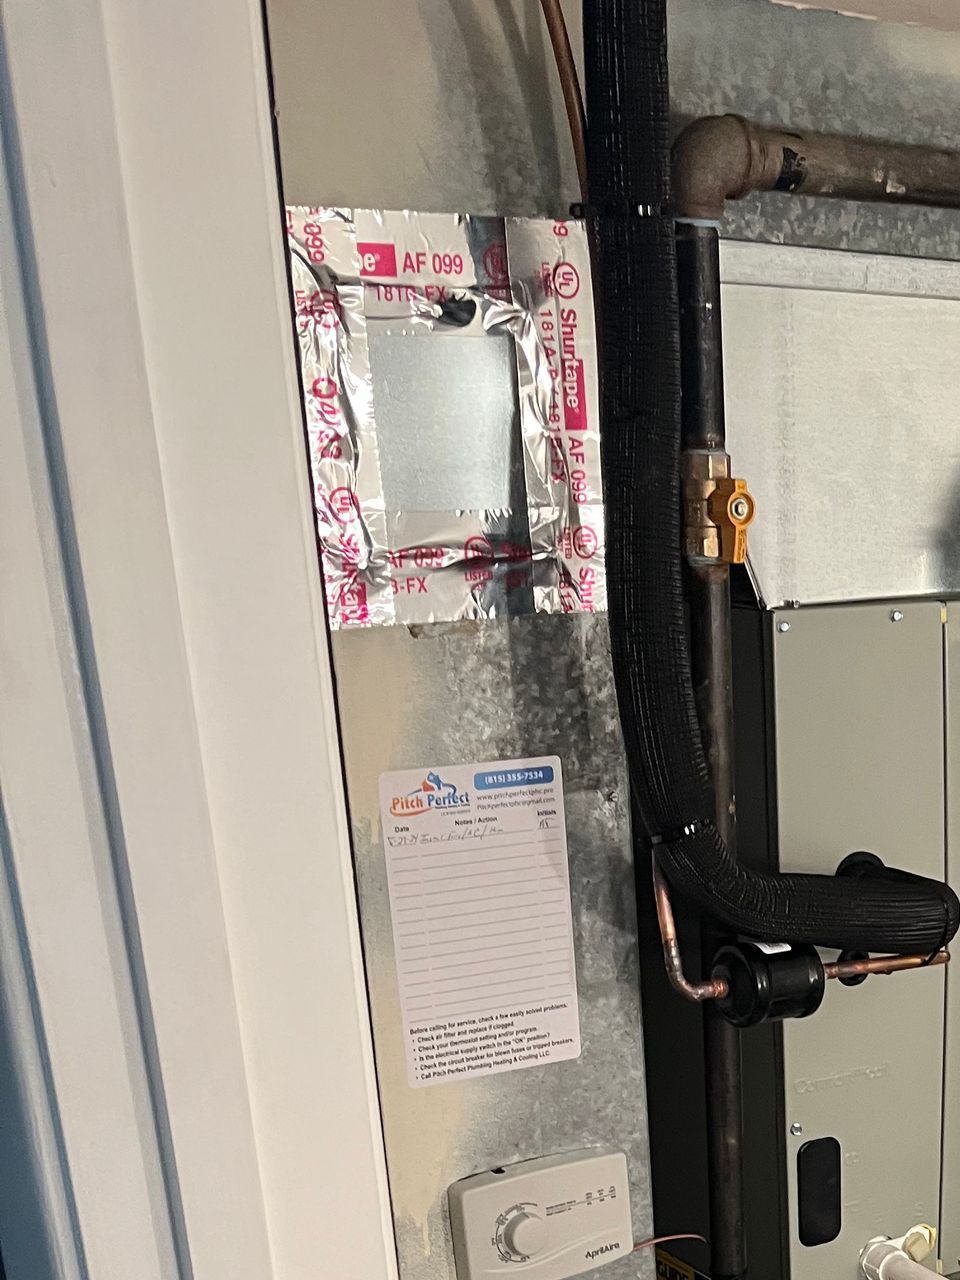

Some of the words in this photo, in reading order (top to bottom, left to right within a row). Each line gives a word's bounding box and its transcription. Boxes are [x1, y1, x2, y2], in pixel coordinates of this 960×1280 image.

[402, 251, 427, 274] AF
[432, 253, 464, 276] 099
[560, 307, 580, 409] Shurtape
[568, 436, 585, 465] AF
[570, 469, 588, 505] 099
[392, 795, 423, 811] Pitch
[427, 792, 470, 807] Perfect
[477, 816, 498, 824] Action
[410, 1027, 428, 1035] Before
[429, 1024, 447, 1032] calling
[479, 1015, 494, 1023] check
[526, 1007, 542, 1015] solved
[417, 1035, 434, 1043] Check
[468, 1026, 487, 1034] replace
[450, 1037, 478, 1047] thermostat
[420, 1063, 437, 1071] Check
[465, 1054, 485, 1062] breaker
[421, 1072, 431, 1080] Call
[433, 1070, 446, 1078] Pitch
[447, 1066, 466, 1075] Perfect
[467, 1062, 492, 1071] Plumbing
[493, 1058, 512, 1066] Heating
[518, 1053, 538, 1062] Cooling
[585, 1242, 620, 1260] AprilAire
